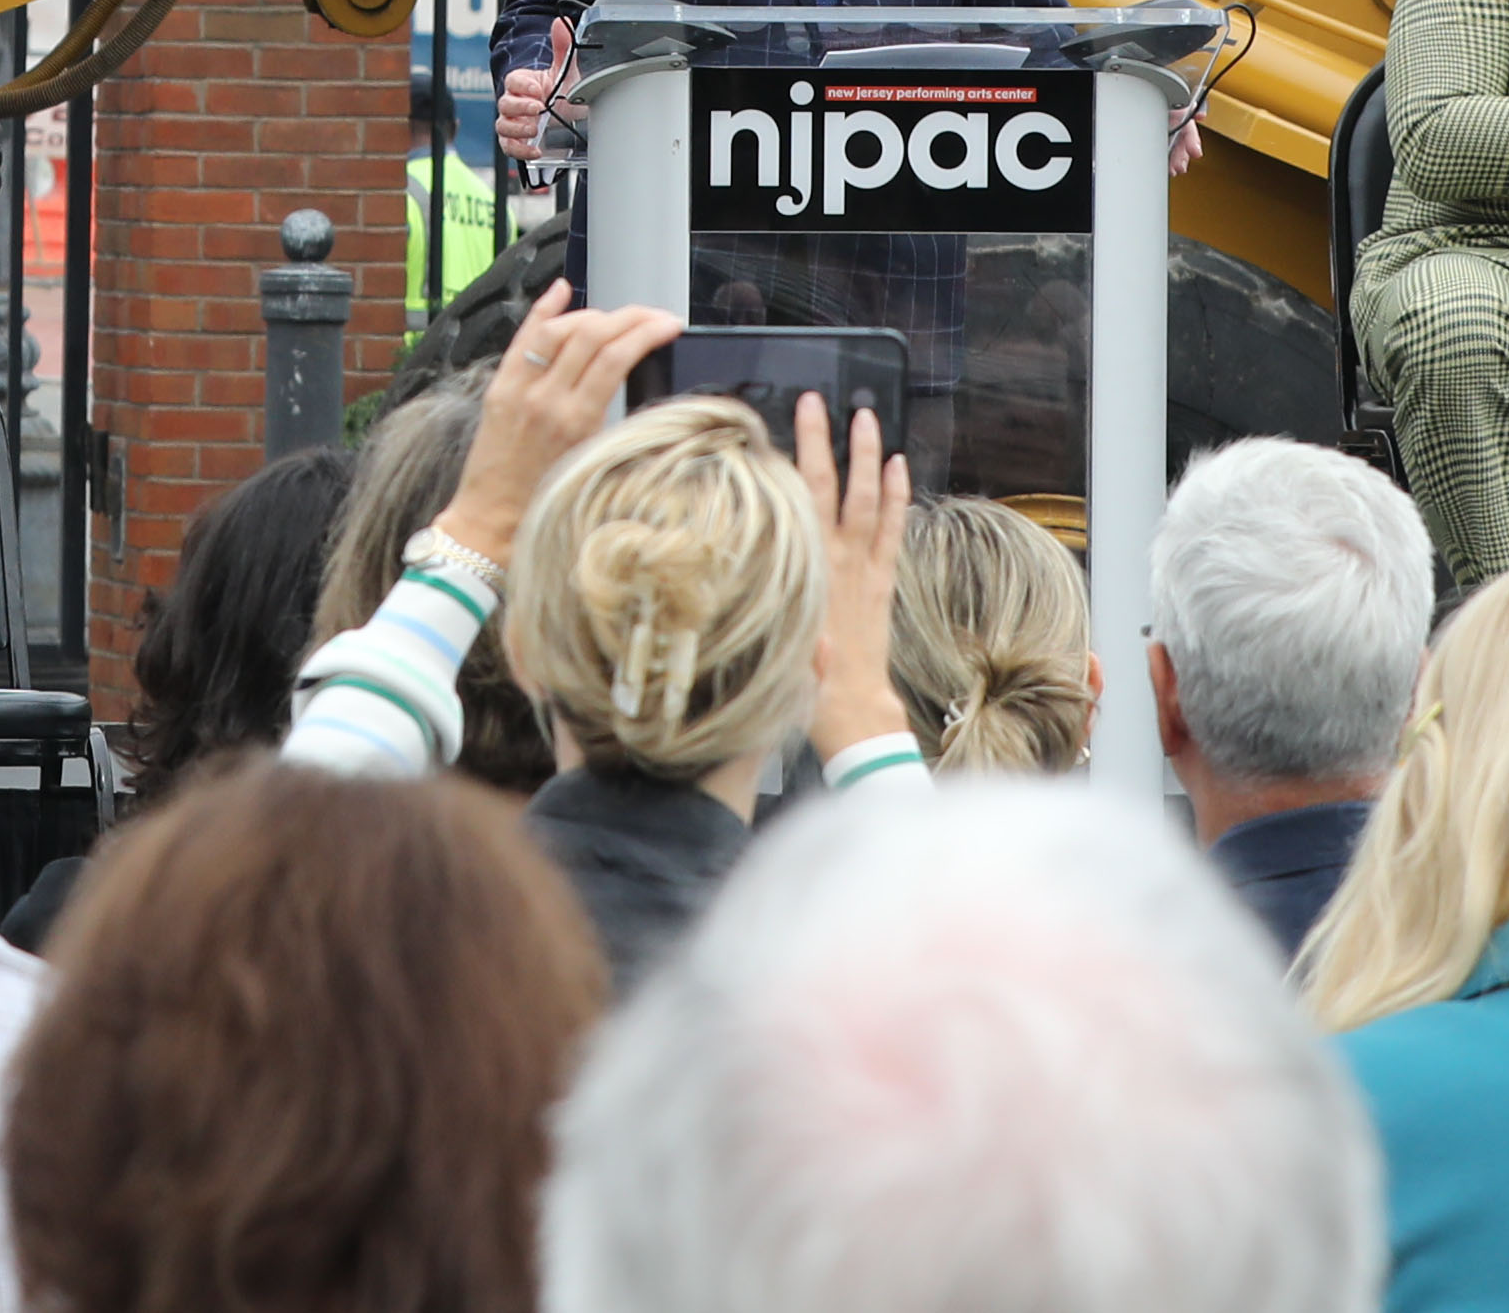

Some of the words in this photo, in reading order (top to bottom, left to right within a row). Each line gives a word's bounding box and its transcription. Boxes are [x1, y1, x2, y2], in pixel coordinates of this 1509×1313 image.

[828, 89, 854, 98] new
[856, 87, 893, 100] jersey
[896, 87, 965, 101] performing
[968, 88, 992, 99] arts
[994, 89, 1033, 100] center
[710, 81, 1073, 215] njpac
